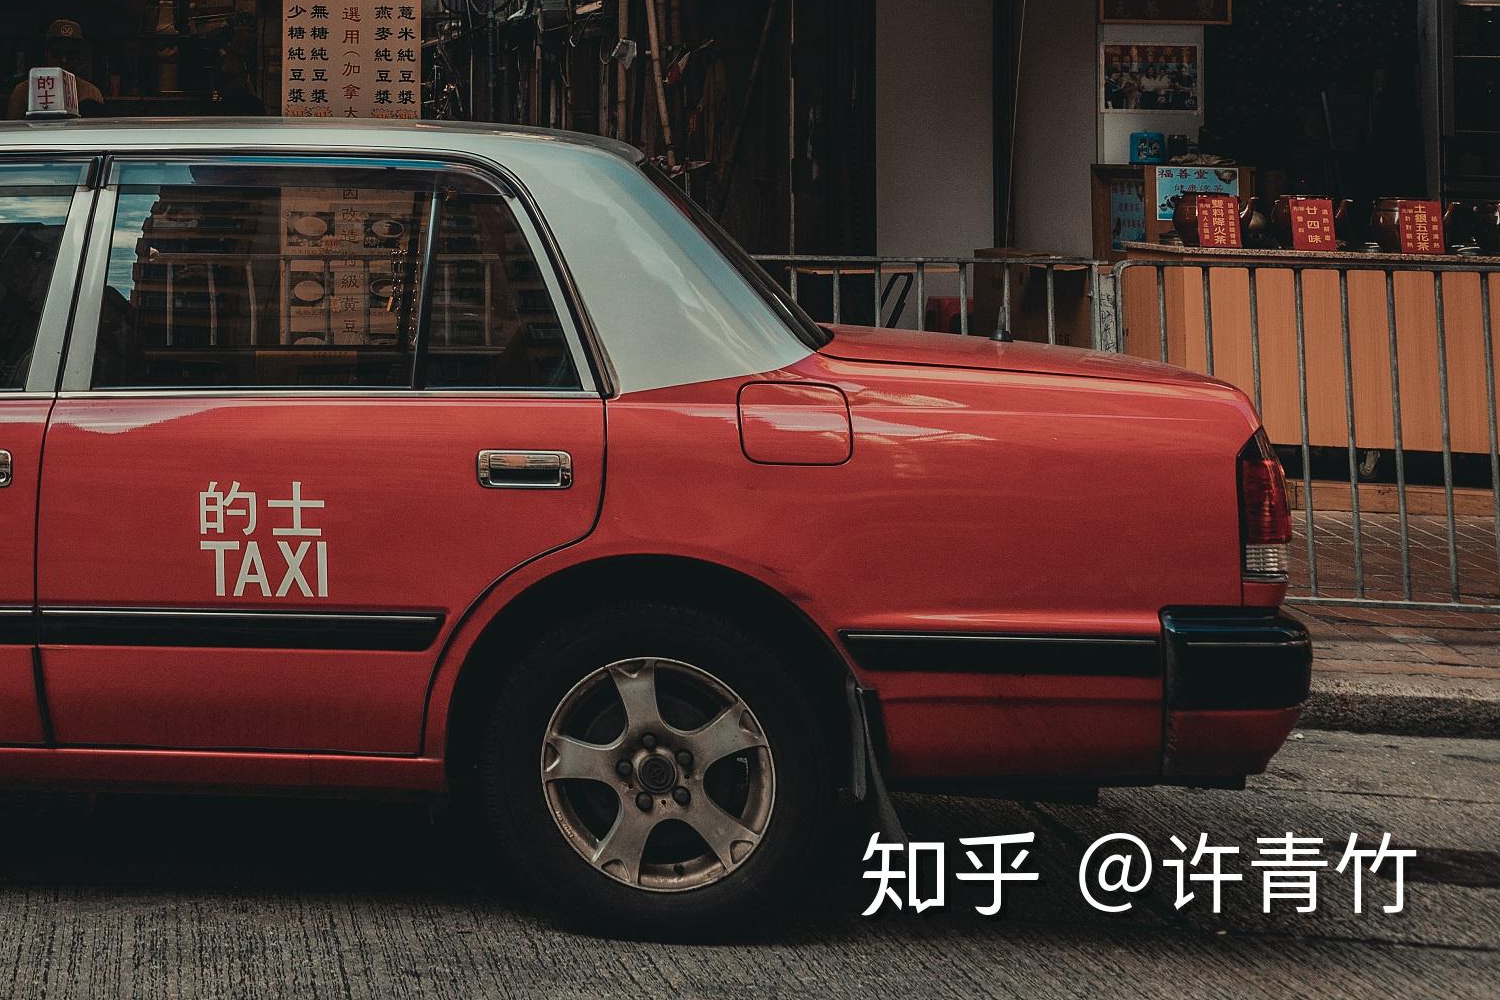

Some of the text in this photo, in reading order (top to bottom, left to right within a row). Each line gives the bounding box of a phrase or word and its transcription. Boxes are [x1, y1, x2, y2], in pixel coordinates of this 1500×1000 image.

[37, 76, 55, 104] 的士
[287, 5, 306, 103] 少糖純豆漿
[310, 5, 329, 103] 無糖純豆漿
[374, 6, 393, 105] 燕麥純豆漿
[397, 6, 416, 105] 薏米純豆漿
[1306, 205, 1322, 243] 廿四味
[198, 481, 326, 537] 的士
[201, 539, 329, 598] TAXI
